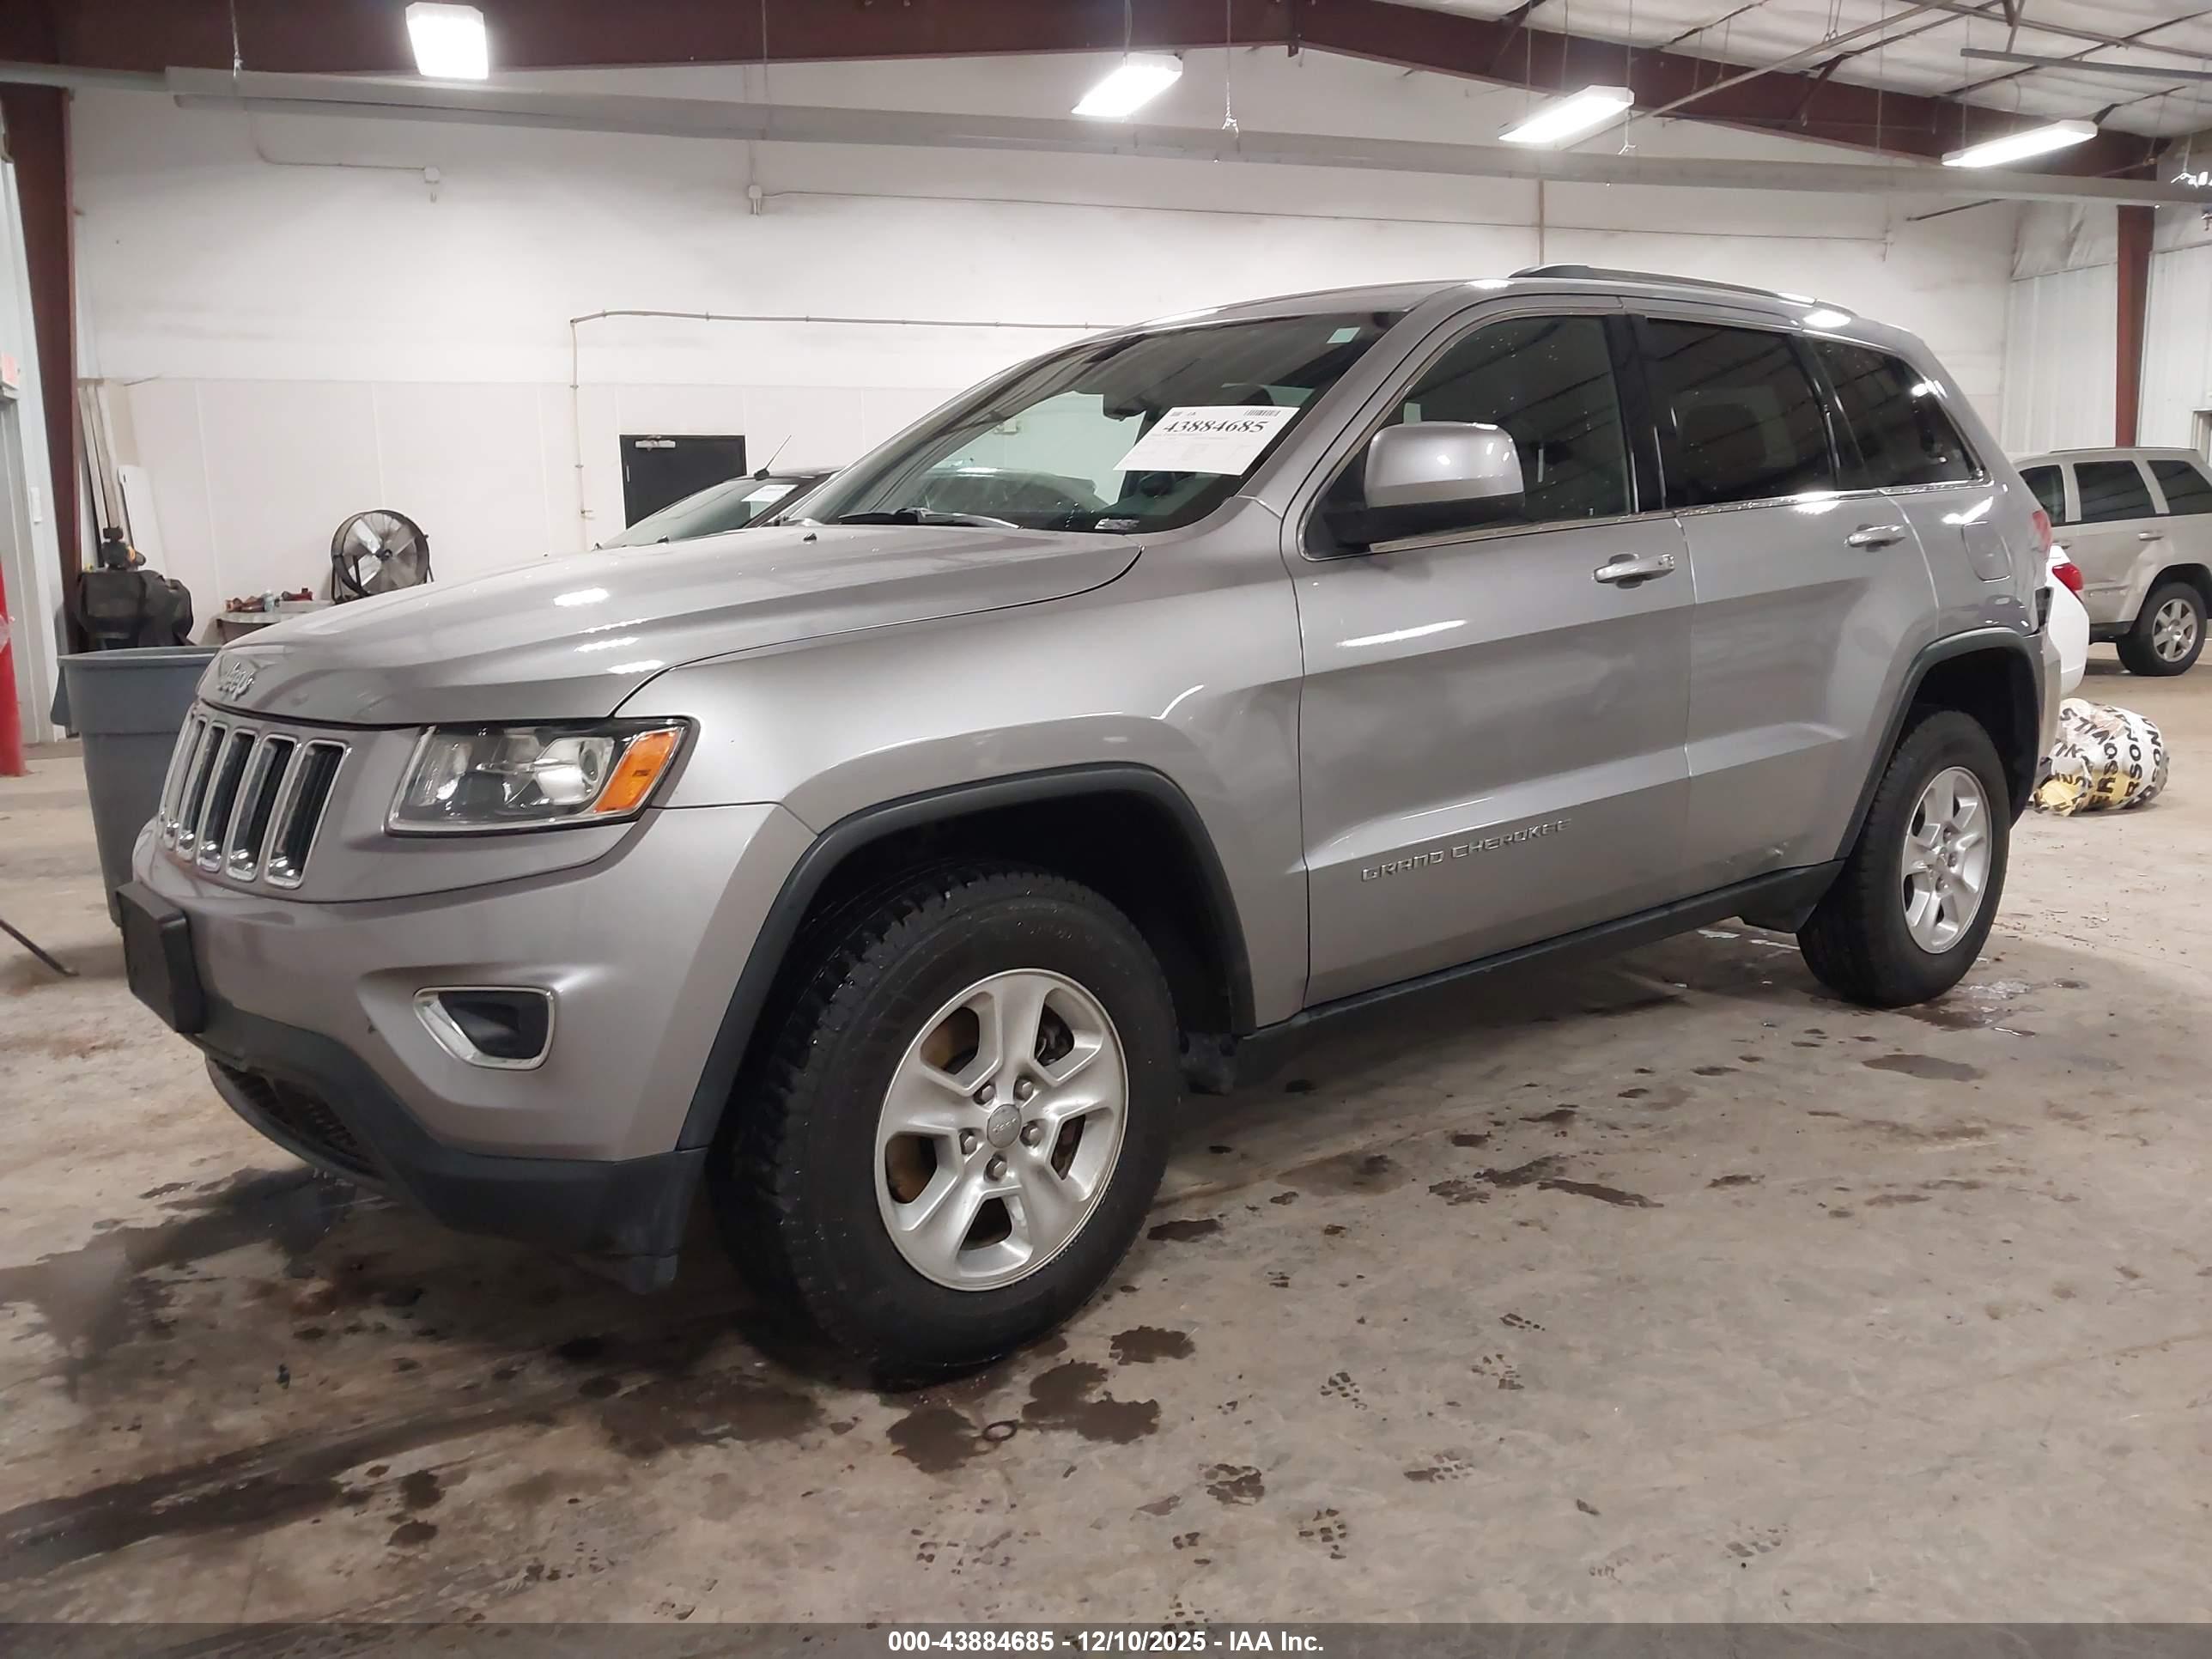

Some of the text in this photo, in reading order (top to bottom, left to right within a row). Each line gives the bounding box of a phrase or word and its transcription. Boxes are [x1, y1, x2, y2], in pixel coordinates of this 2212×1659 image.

[1164, 419, 1269, 434] 43884685
[1361, 817, 1572, 882] GRAND CHEROKEE
